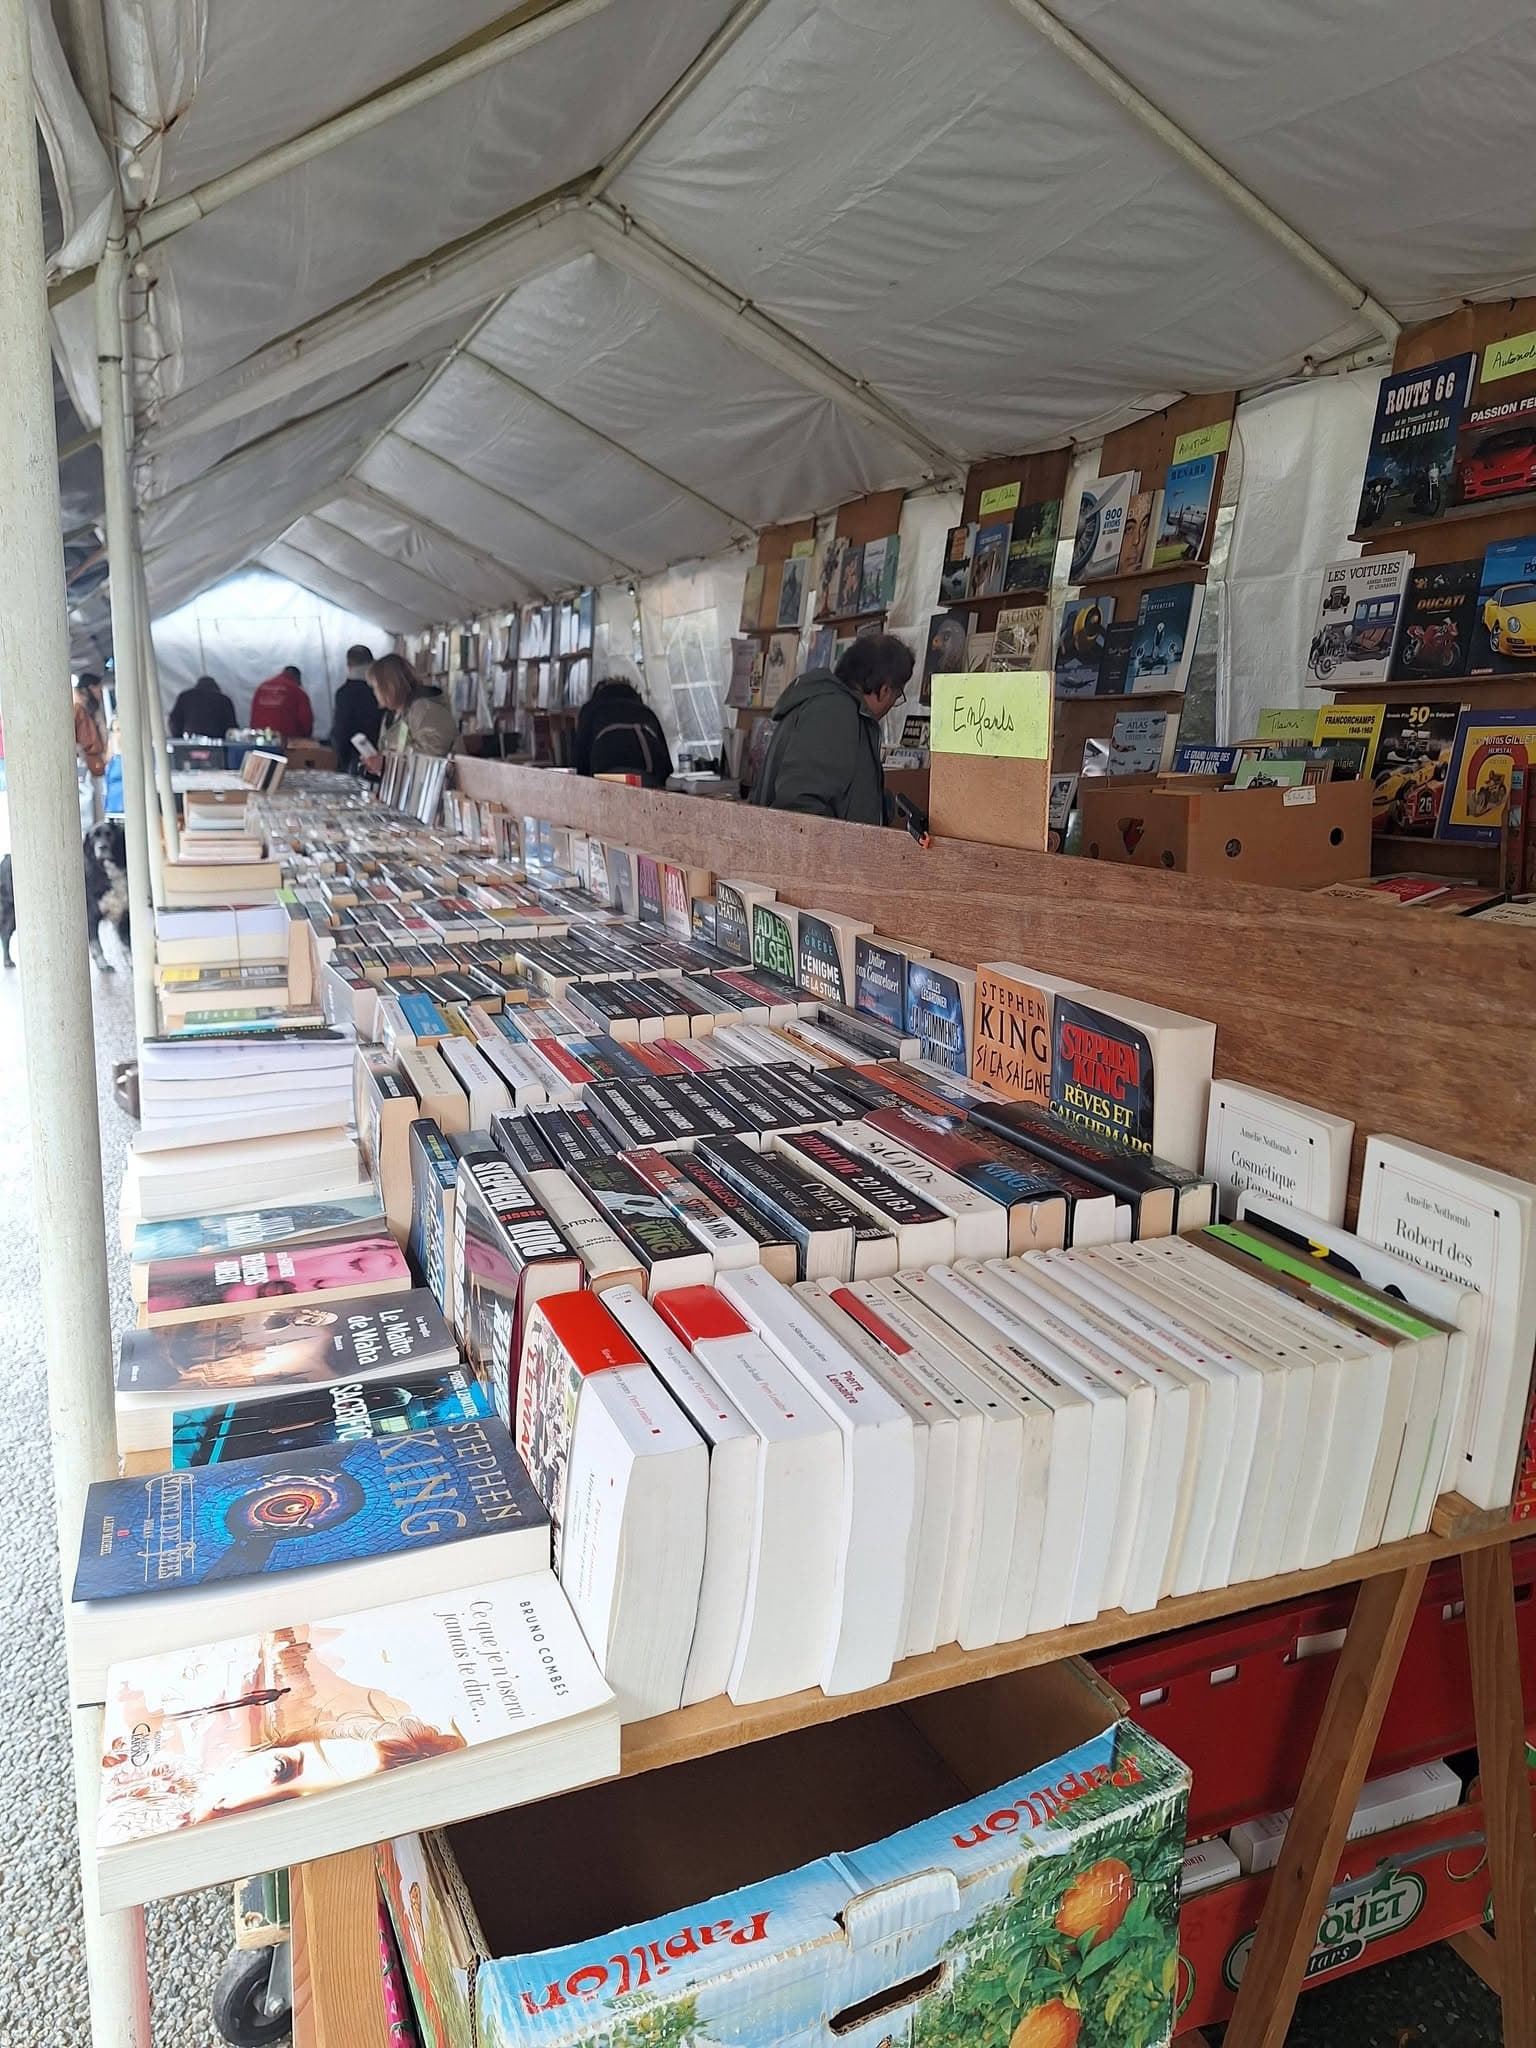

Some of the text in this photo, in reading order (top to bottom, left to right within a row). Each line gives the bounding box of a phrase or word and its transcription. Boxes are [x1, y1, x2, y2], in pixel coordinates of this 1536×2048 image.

[1385, 372, 1456, 415] ROUTE 66
[1470, 401, 1518, 423] PASSION
[1381, 416, 1450, 444] HARLEY-DAVIDSON
[1105, 507, 1123, 520] 800
[1327, 562, 1400, 583] LES VOITURES
[1416, 594, 1466, 609] DUCATI
[1325, 715, 1376, 725] FRANCORCHAMPS
[1408, 706, 1430, 723] 50
[1188, 760, 1220, 774] TRAINS
[1206, 752, 1220, 760] LIVRE
[1221, 753, 1231, 761] DES
[757, 910, 791, 947] ADLER
[754, 936, 794, 978] OLSEN
[800, 950, 840, 985] L'ÉNIGME
[868, 950, 886, 971] Didier
[801, 974, 810, 987] DE
[810, 977, 819, 990] LA
[819, 980, 841, 1003] STUGA
[982, 981, 1046, 1023] STEPHEN
[979, 1002, 1048, 1063] KING
[1061, 1022, 1140, 1087] STEPHEN
[1073, 1055, 1126, 1100] KING
[1064, 1083, 1134, 1129] RÊVES ET
[1262, 1135, 1292, 1156] Nothomb
[979, 1162, 1029, 1189] KING
[1230, 1150, 1297, 1191] Cosmétique
[1230, 1174, 1245, 1188] de
[471, 1161, 537, 1212] STEPHEN
[507, 1219, 568, 1257] KING
[851, 1175, 917, 1213] 22/11/63
[684, 1198, 722, 1227] STEPHEN
[708, 1221, 739, 1241] KING
[1431, 1201, 1471, 1229] Nothomb
[633, 1219, 676, 1253] KING
[655, 1218, 696, 1251] STEPHEN
[1395, 1217, 1473, 1268] Robert des
[346, 1313, 383, 1366] de Waha
[379, 1308, 414, 1357] Le Maître
[839, 1369, 866, 1393] Pierre
[377, 1429, 469, 1538] KING
[447, 1421, 523, 1523] STEPHEN
[433, 1612, 470, 1659] jamais
[457, 1662, 477, 1675] te
[468, 1601, 535, 1720] Ce que je n'oserai
[520, 1600, 569, 1697] BRUNO COMBES
[130, 1732, 143, 1761] LAFON
[1317, 1890, 1407, 1946] QUET
[520, 1911, 772, 2015] Papillon
[1310, 1945, 1351, 1971] tars
